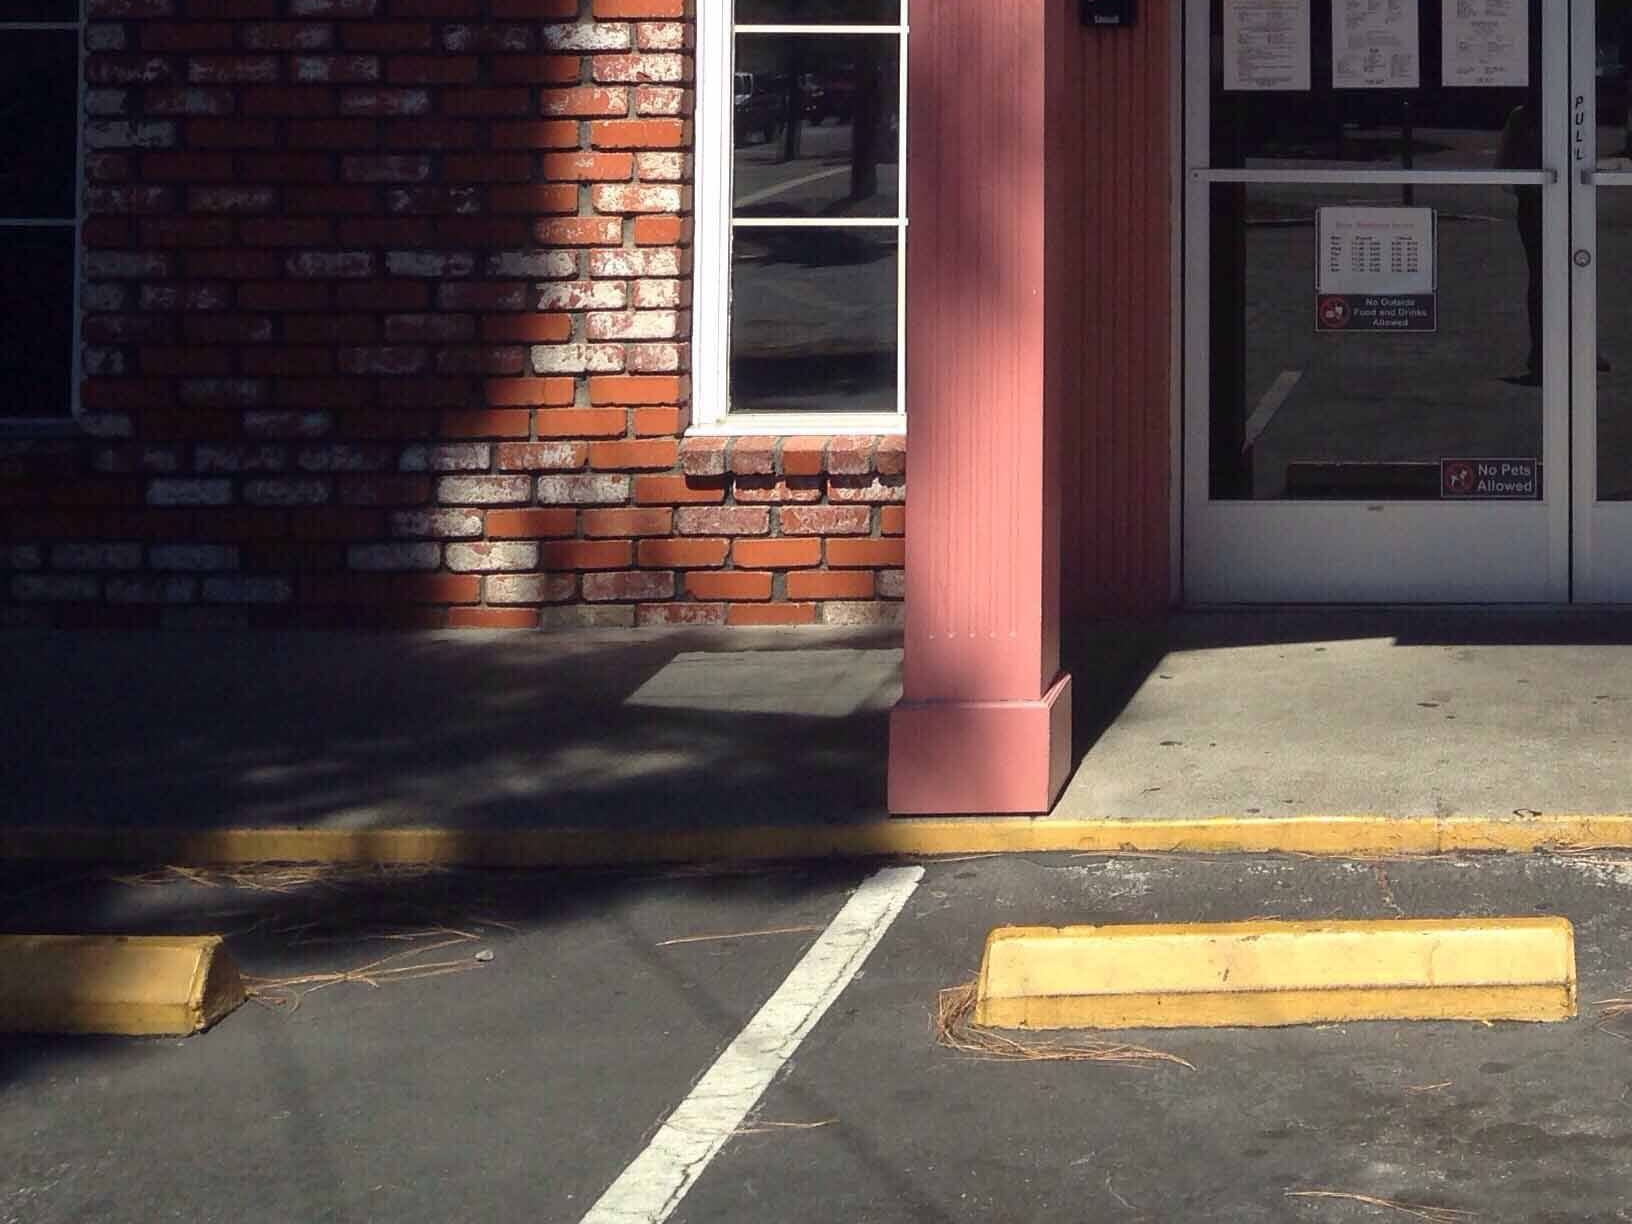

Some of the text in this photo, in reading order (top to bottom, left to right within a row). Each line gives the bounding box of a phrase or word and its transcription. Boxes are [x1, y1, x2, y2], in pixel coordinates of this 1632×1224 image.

[1575, 95, 1584, 161] PULL
[1365, 297, 1379, 307] No
[1353, 308, 1428, 317] Food and Drinks
[1372, 318, 1409, 328] Allowed
[1478, 463, 1531, 476] No Pets
[1477, 479, 1533, 492] Allowed
